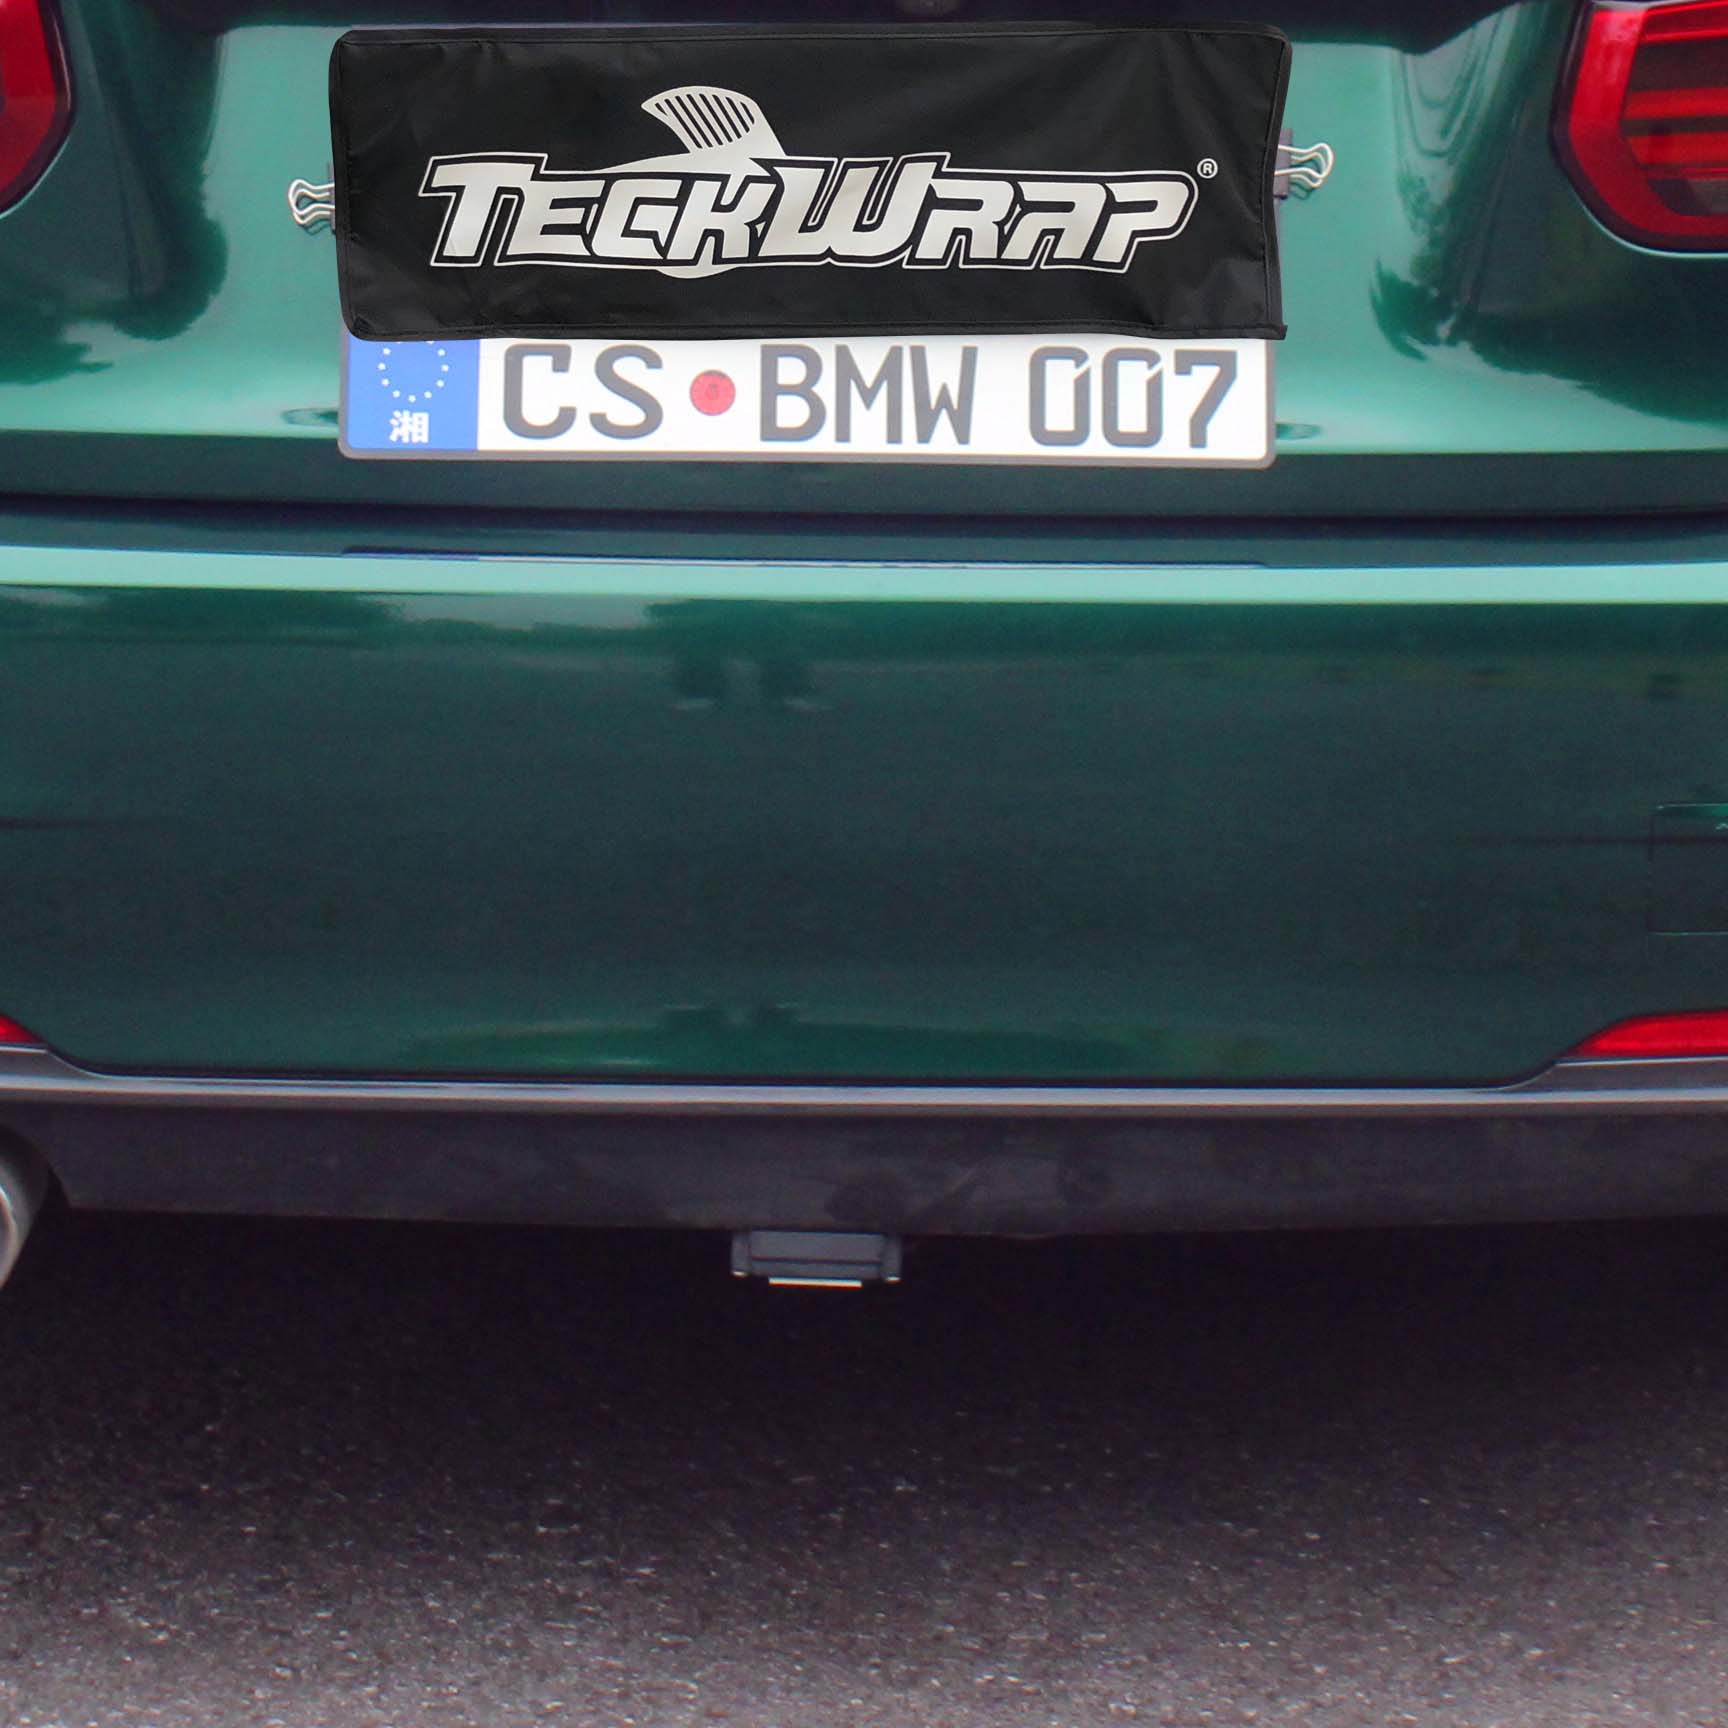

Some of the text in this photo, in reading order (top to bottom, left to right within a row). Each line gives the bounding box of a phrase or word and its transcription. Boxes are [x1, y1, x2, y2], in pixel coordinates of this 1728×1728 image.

[389, 409, 430, 444] 湘
[501, 342, 1239, 450] CS BMW 007
